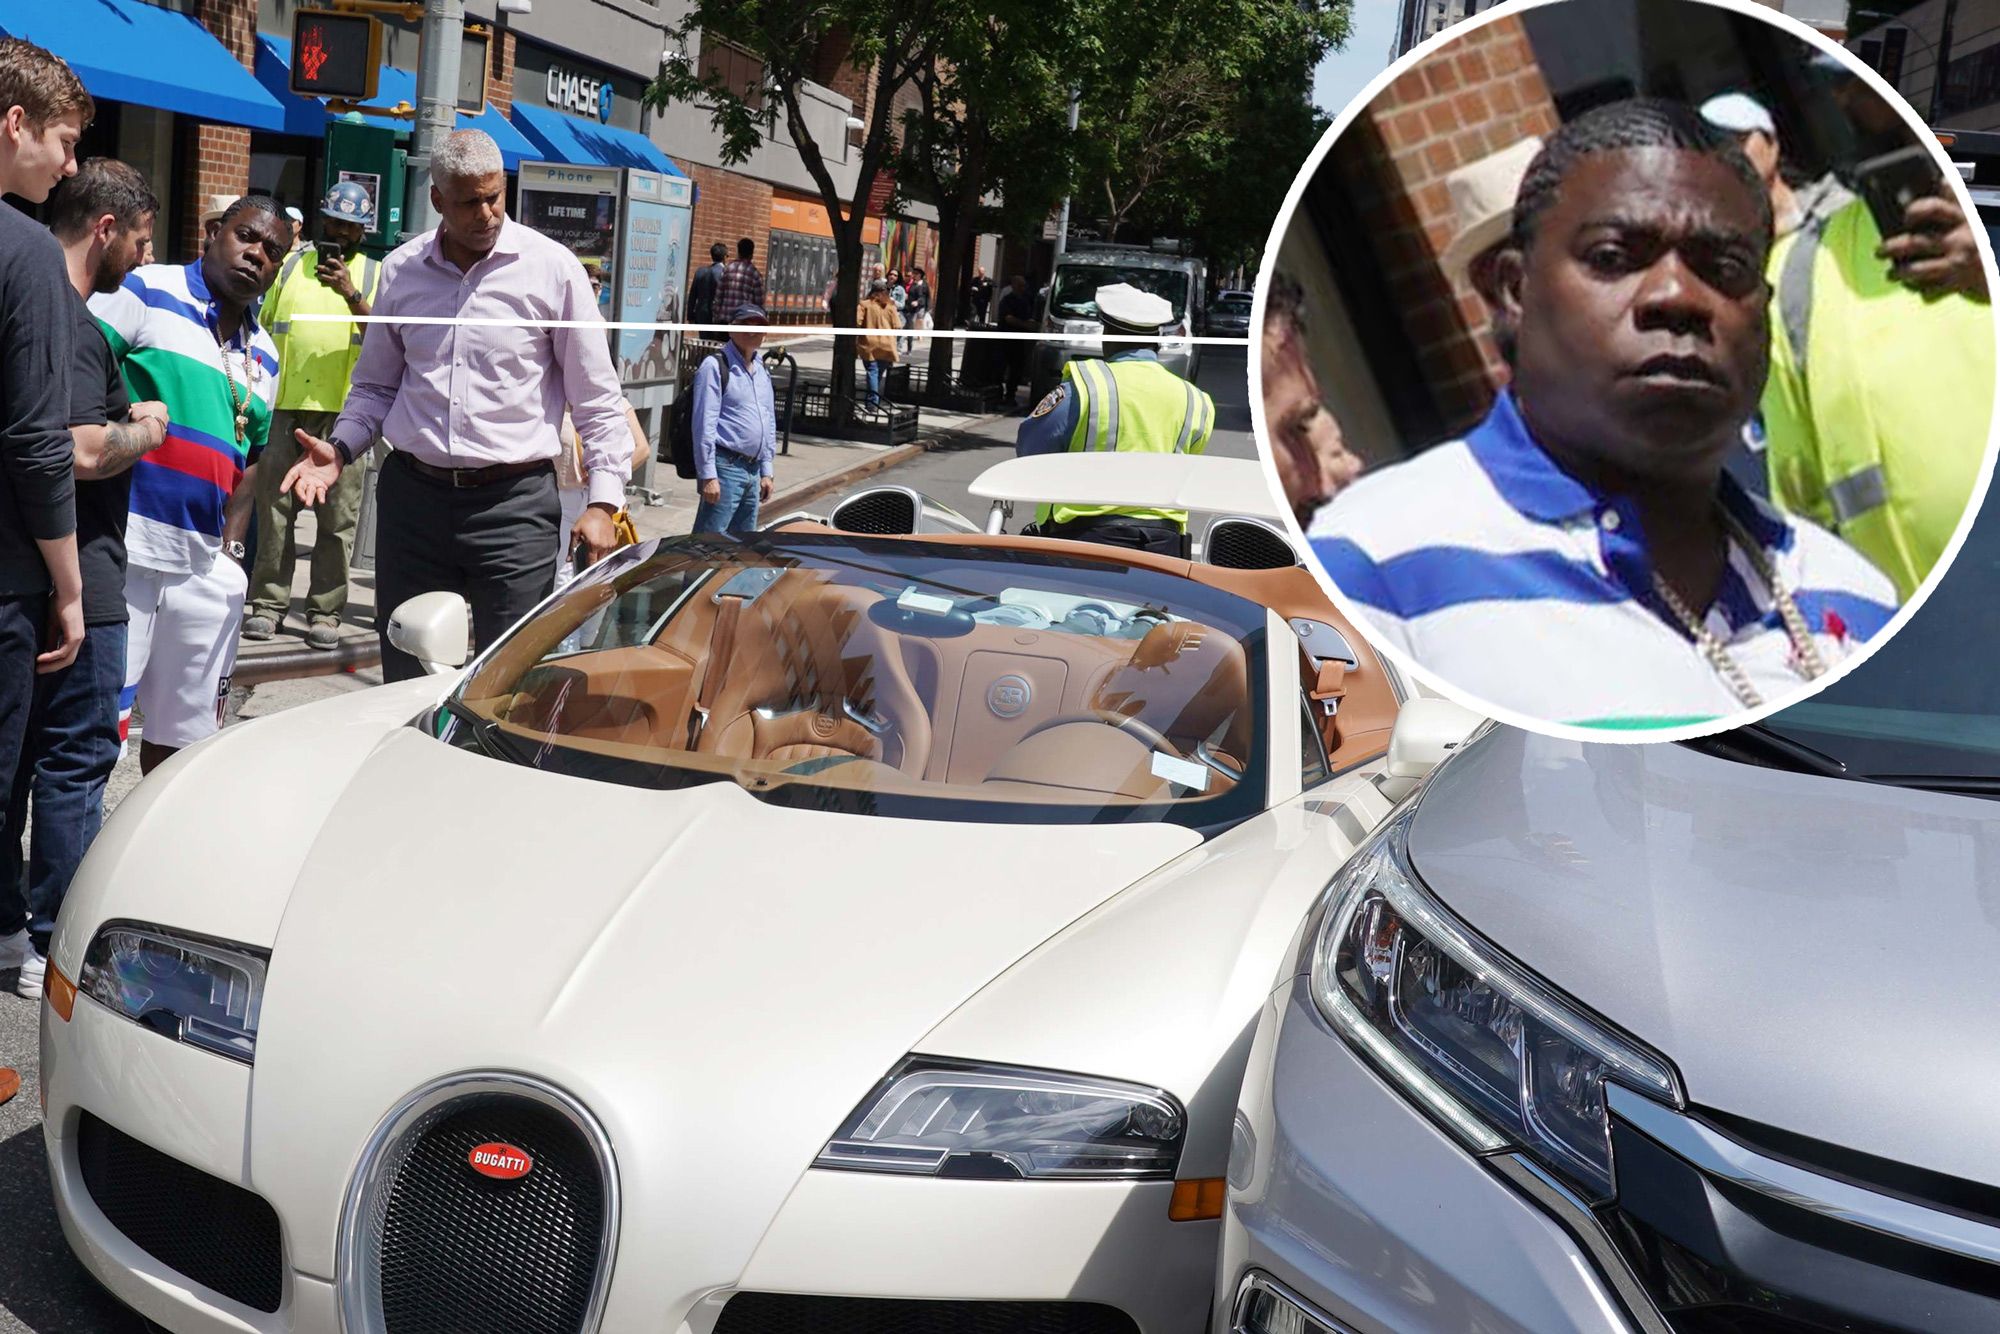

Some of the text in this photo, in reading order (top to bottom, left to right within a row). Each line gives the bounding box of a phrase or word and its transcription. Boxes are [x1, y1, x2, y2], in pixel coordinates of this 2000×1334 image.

[547, 68, 600, 115] CHASE
[547, 169, 593, 183] Phone
[548, 206, 586, 219] LIFE TIME
[474, 1151, 525, 1172] BUGATTI
